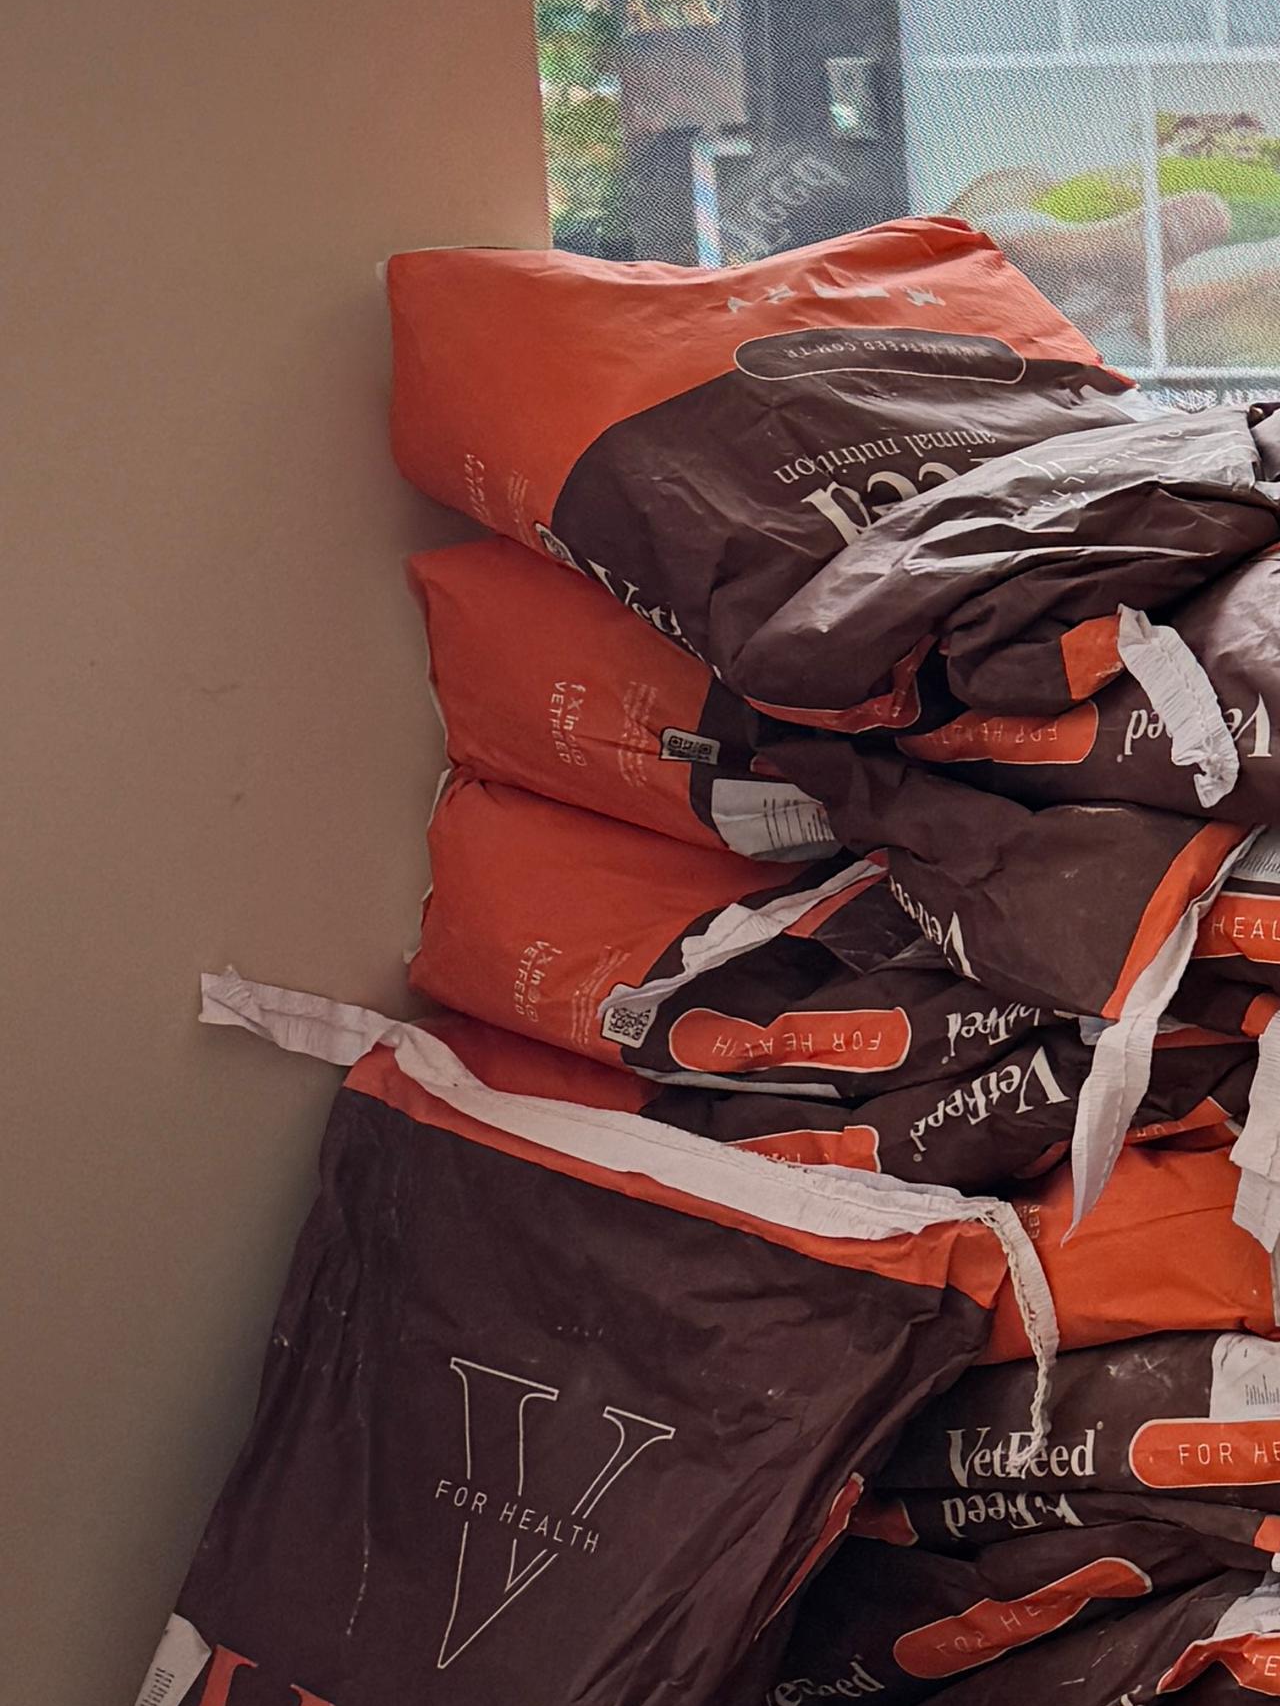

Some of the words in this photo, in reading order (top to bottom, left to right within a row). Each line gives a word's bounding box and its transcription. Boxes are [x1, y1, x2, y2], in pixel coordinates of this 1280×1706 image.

[831, 1031, 882, 1053] FOR
[1178, 1441, 1237, 1466] FOR
[435, 1479, 489, 1517] FOR
[498, 1496, 601, 1554] HEALTH
